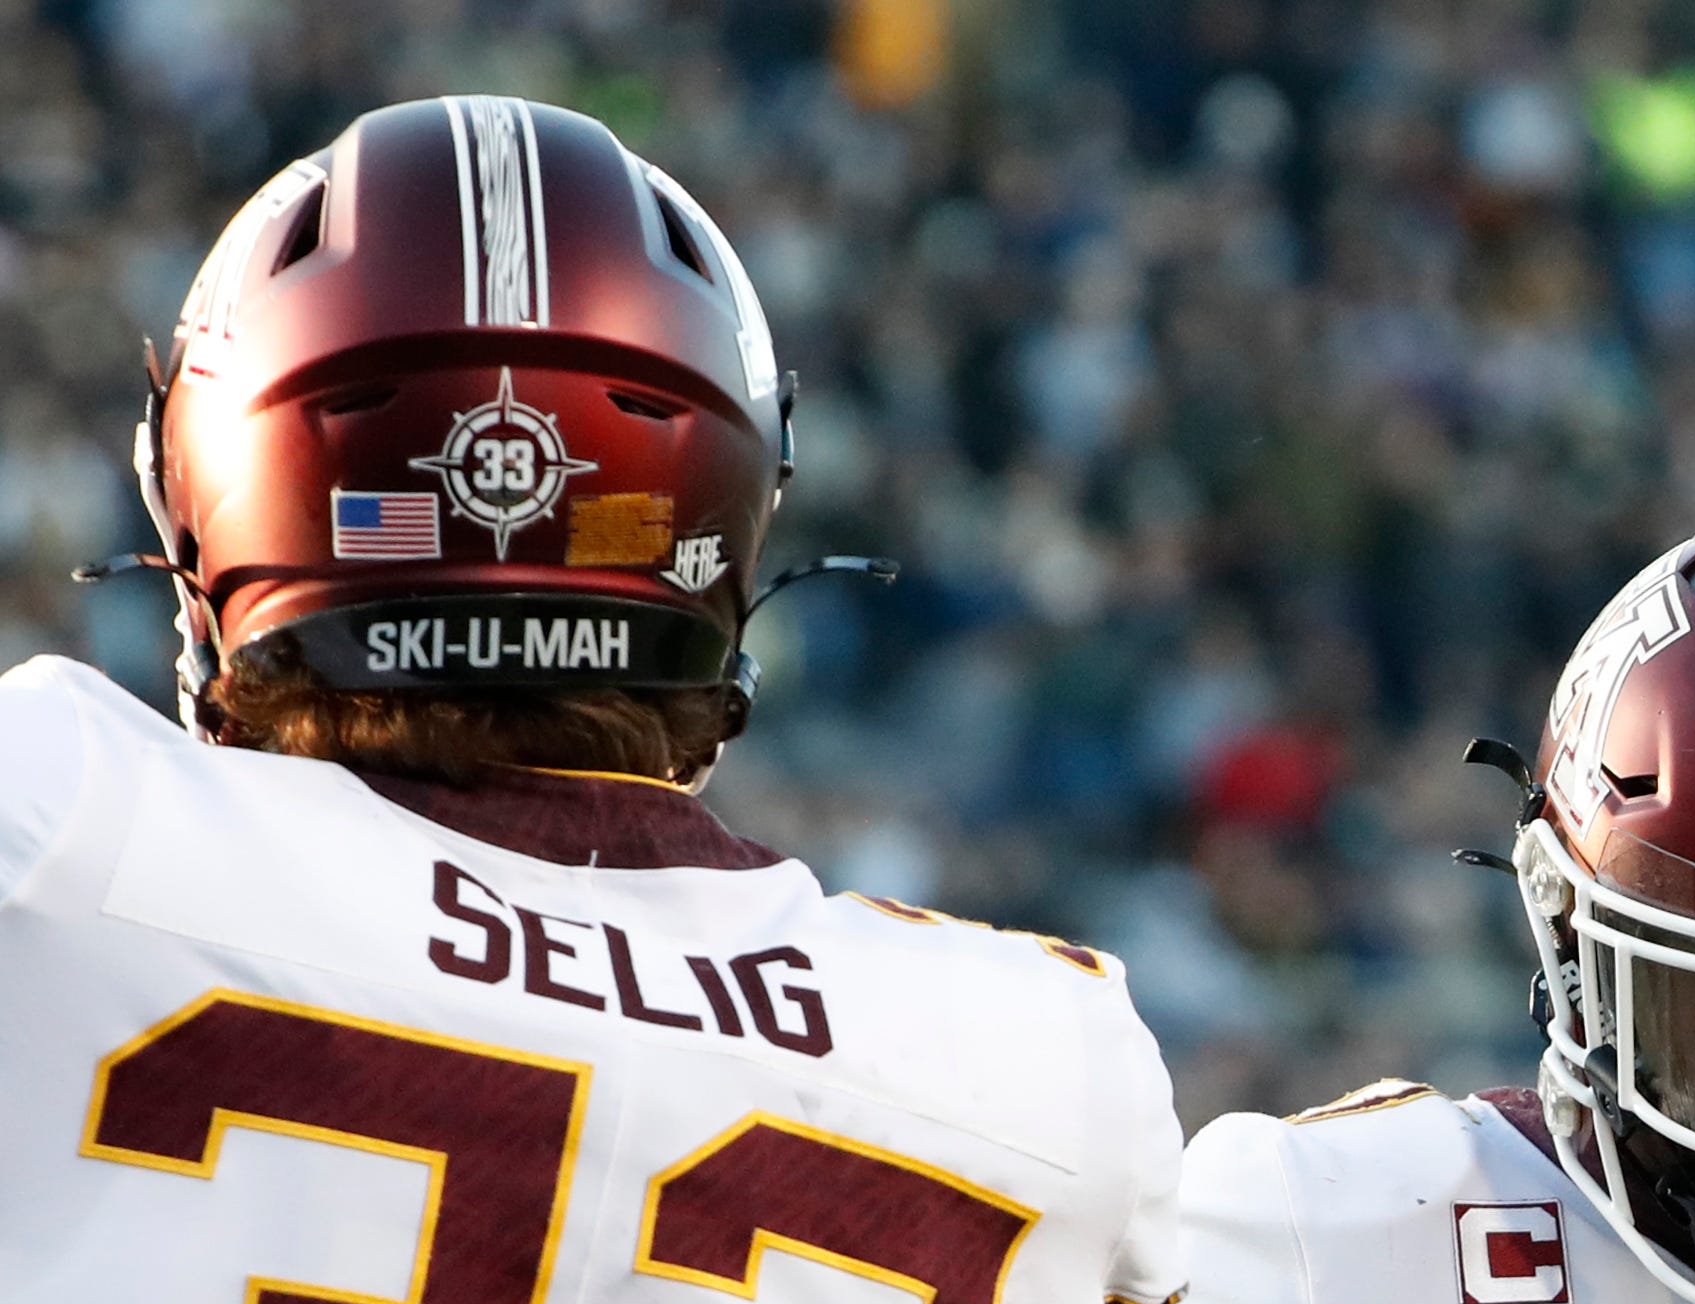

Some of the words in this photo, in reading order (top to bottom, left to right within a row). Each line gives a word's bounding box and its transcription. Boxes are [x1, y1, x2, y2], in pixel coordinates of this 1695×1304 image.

[471, 438, 536, 491] 33
[674, 533, 723, 589] HERE
[366, 617, 630, 673] SKI-U-MAH
[428, 860, 833, 1058] SELIG
[1459, 1207, 1565, 1304] C
